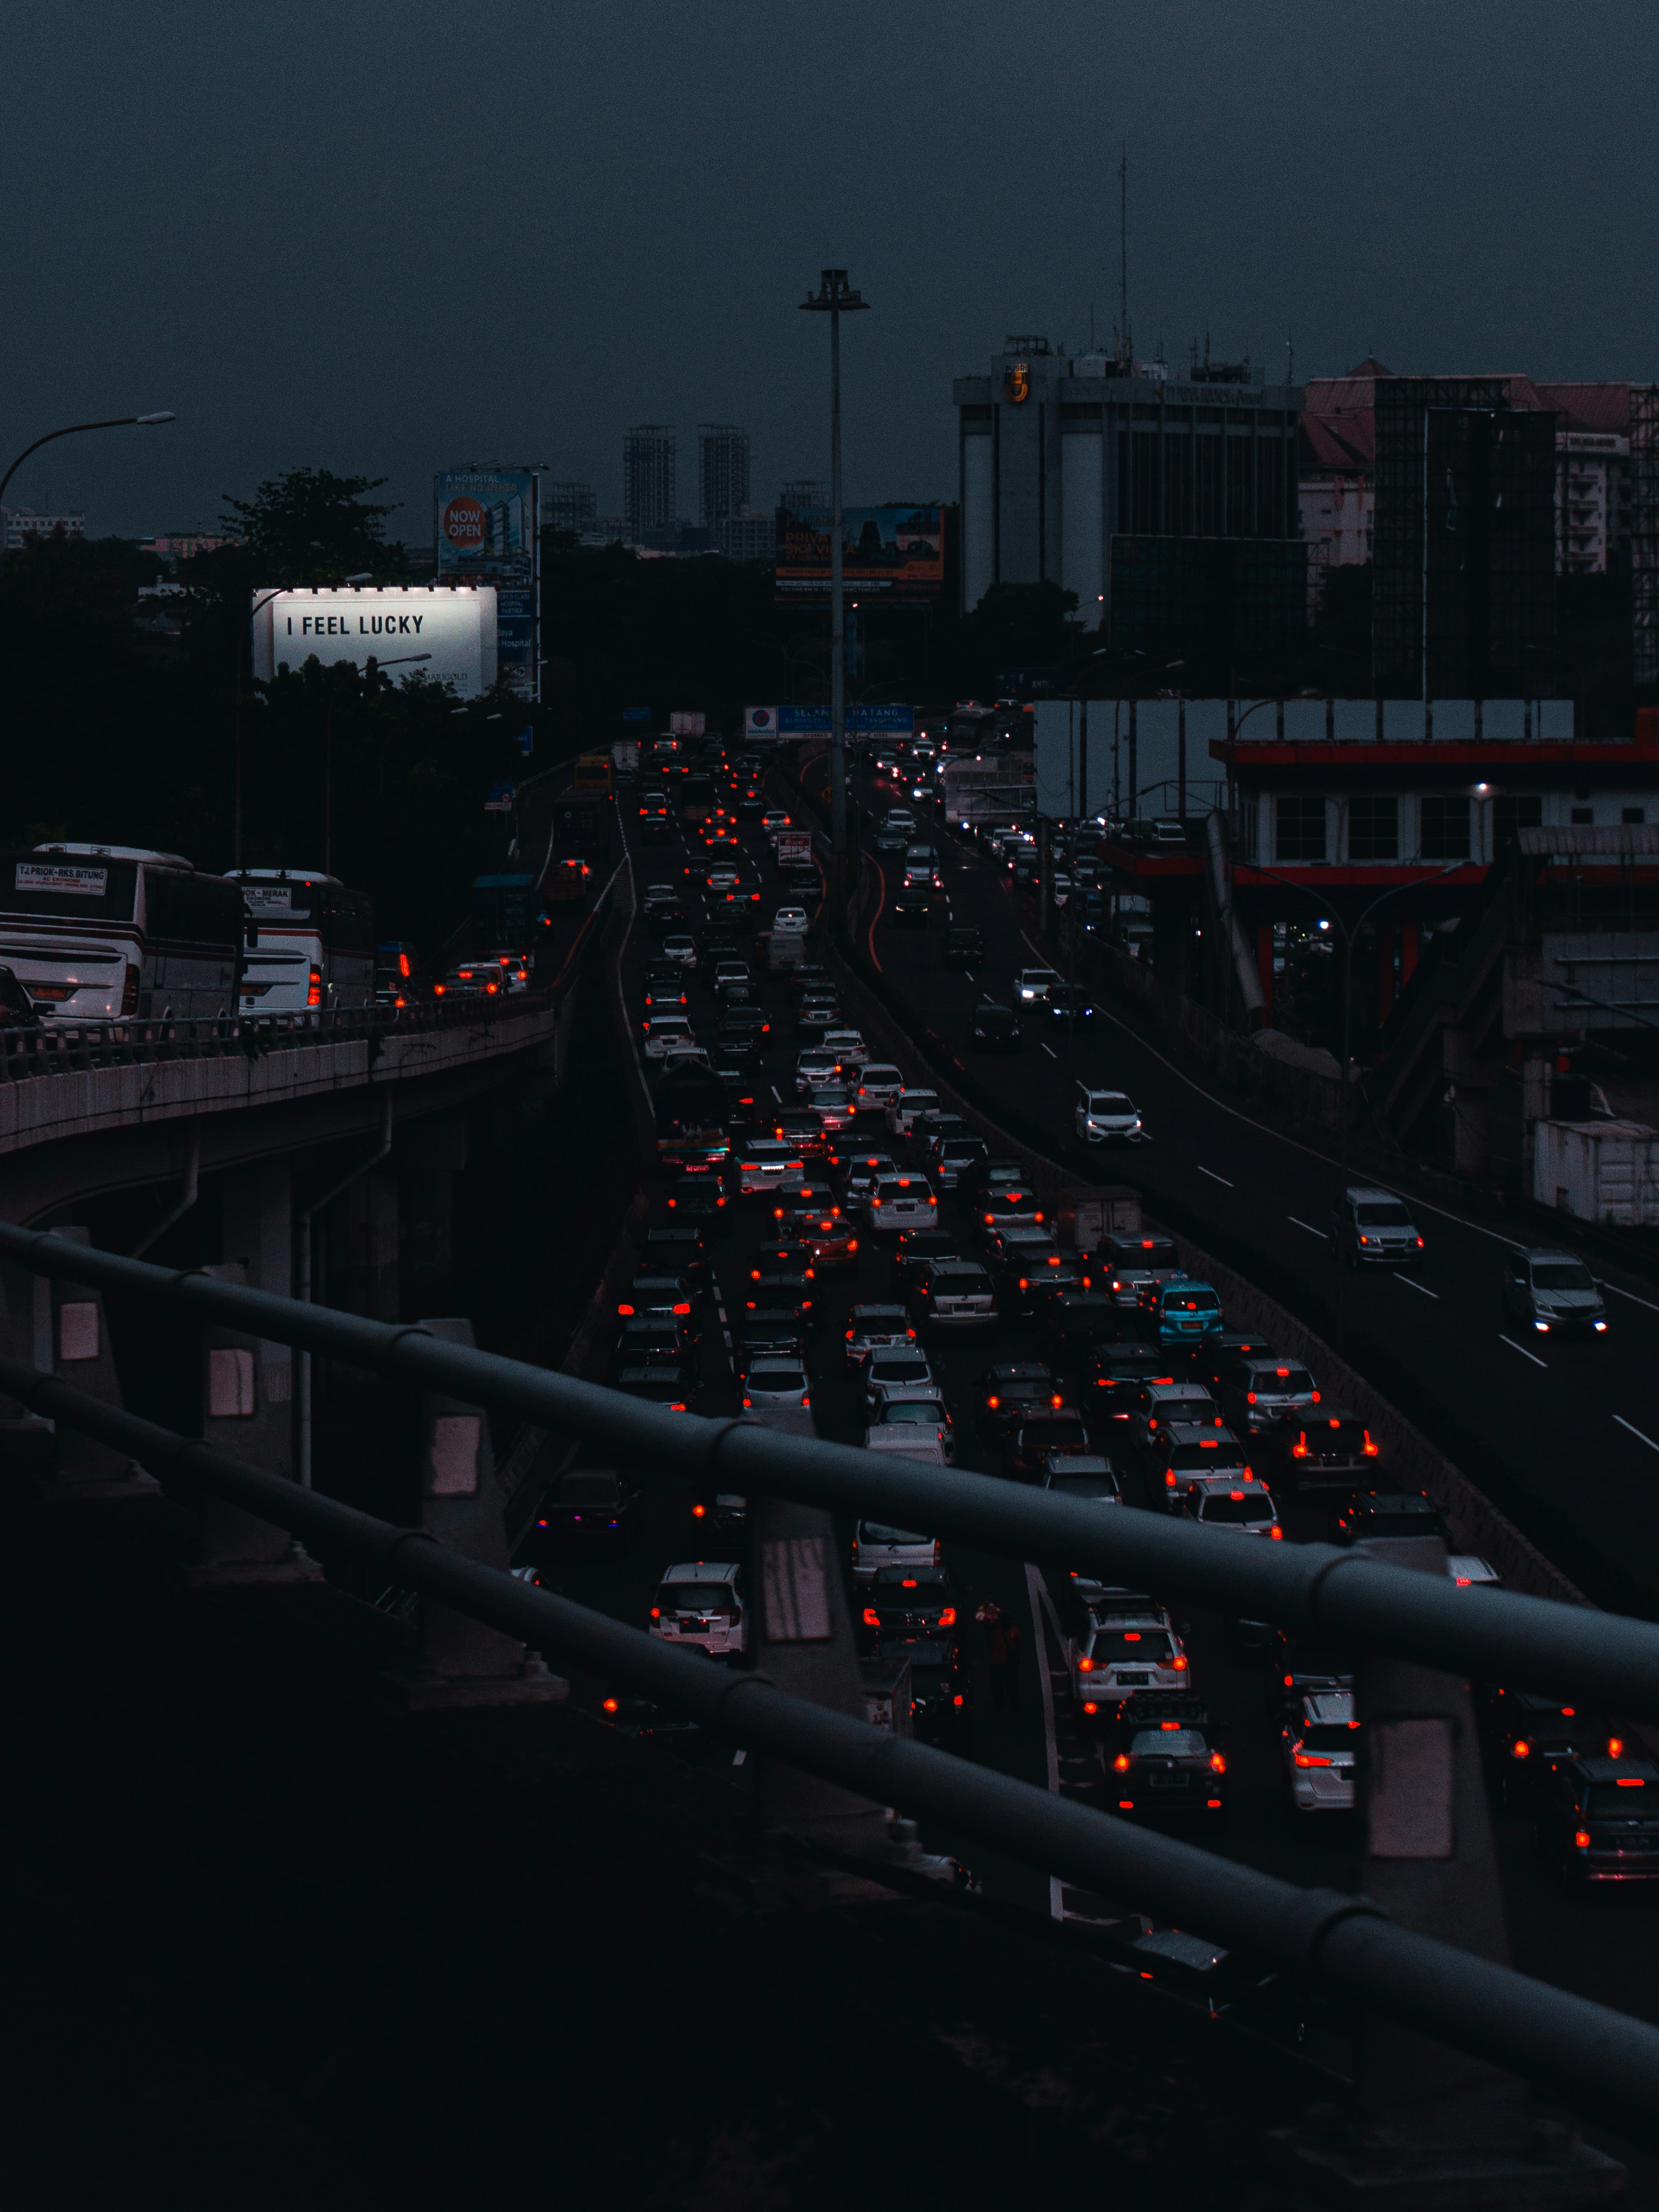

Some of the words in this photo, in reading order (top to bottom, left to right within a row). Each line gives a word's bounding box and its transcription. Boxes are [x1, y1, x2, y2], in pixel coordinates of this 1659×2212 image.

[445, 474, 452, 483] A
[455, 475, 500, 483] HOSPITAL
[446, 484, 469, 492] LIKE
[471, 484, 484, 492] NO
[449, 509, 481, 523] NOW
[449, 524, 481, 536] OPEN
[287, 616, 292, 635] I
[302, 616, 350, 635] FEEL
[360, 615, 424, 635] LUCKY
[501, 639, 531, 649] Hospital
[424, 673, 468, 681] MARIGOLD
[852, 708, 898, 716] DATANG
[262, 889, 288, 897] MERAK
